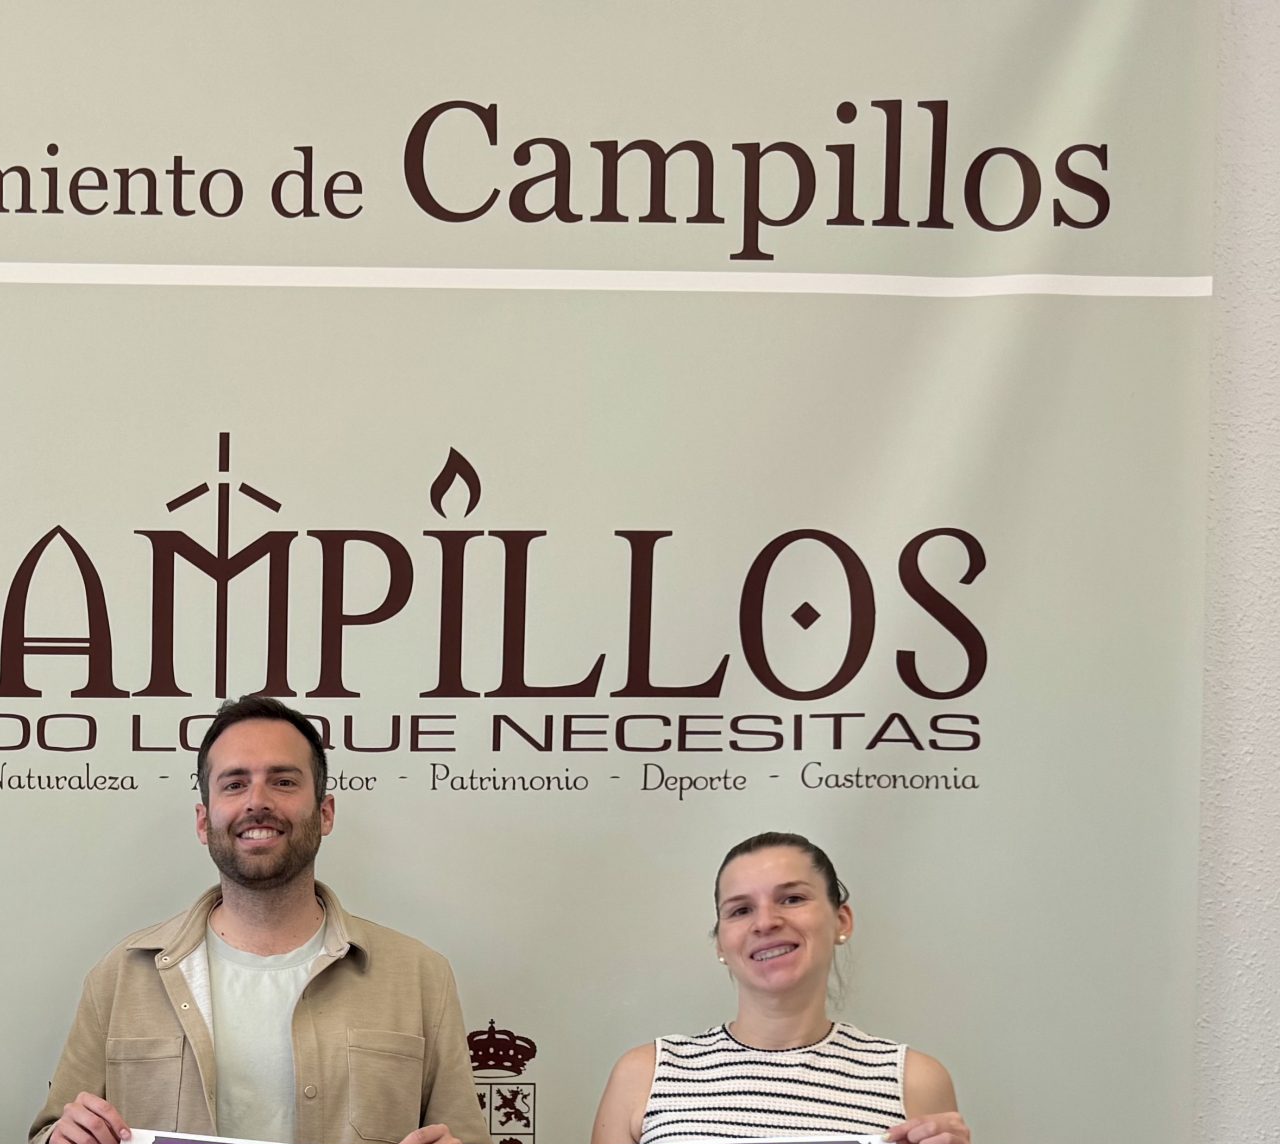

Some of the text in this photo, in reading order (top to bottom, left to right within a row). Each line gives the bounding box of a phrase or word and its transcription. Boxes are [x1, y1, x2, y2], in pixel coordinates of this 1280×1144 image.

[271, 146, 364, 220] de
[404, 99, 1110, 262] Campillos
[304, 713, 456, 752] UE
[492, 713, 981, 752] NECESITAS
[326, 770, 376, 791] otor
[430, 763, 589, 791] Patrimonio
[641, 763, 748, 800] Deporte
[800, 762, 981, 791] Gastronomia
